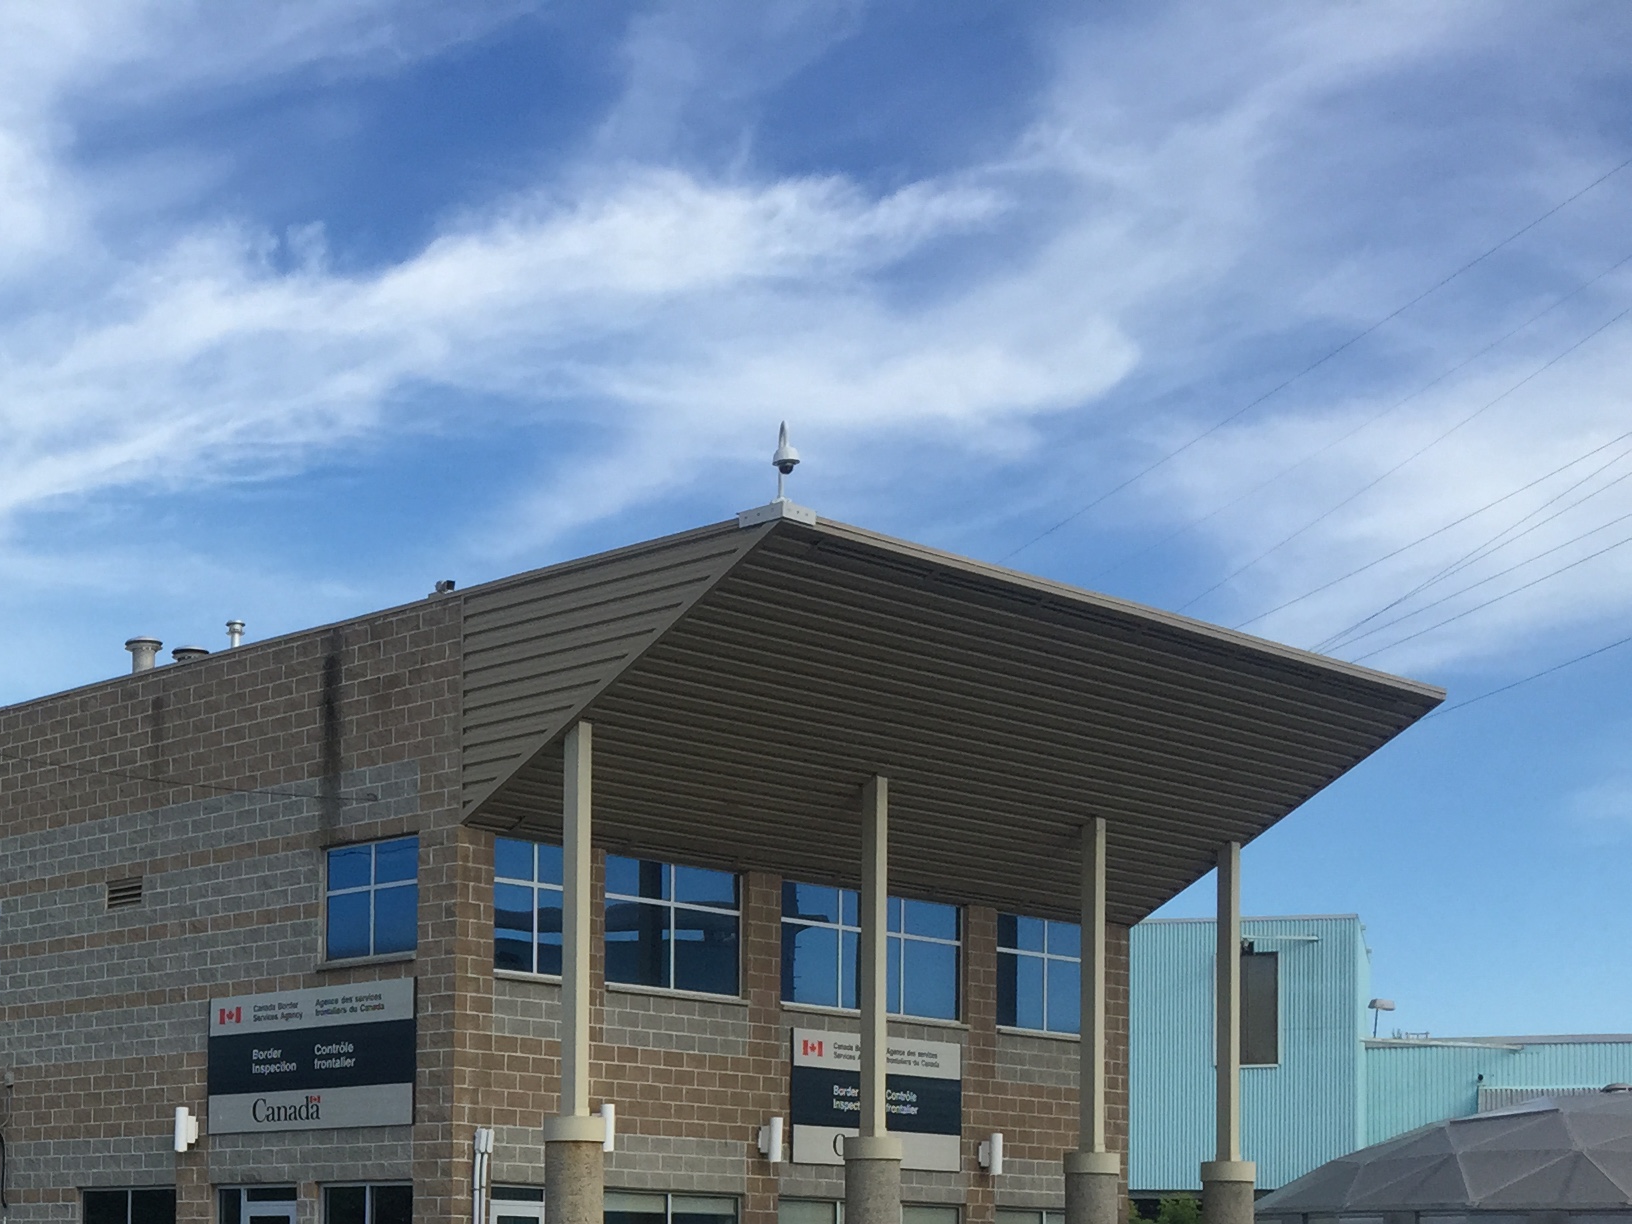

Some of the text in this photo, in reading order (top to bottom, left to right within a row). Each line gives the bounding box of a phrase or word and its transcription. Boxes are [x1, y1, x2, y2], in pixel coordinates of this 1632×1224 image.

[315, 992, 382, 1008] Agence des services
[253, 1001, 299, 1013] Canada Border
[315, 1002, 385, 1017] frontaliers du Canada
[253, 1010, 303, 1022] Services Agency
[314, 1041, 354, 1056] Contrôle
[833, 1042, 854, 1051] Canada
[252, 1048, 282, 1060] Border
[833, 1051, 856, 1061] Services
[886, 1047, 938, 1060] Agence des services
[252, 1060, 297, 1075] Inspection
[314, 1056, 356, 1070] frontalier
[920, 1059, 940, 1069] Canada
[833, 1084, 860, 1097] Border
[886, 1089, 917, 1101] Contrôle
[252, 1095, 321, 1123] Canada
[833, 1098, 861, 1112] Inspect
